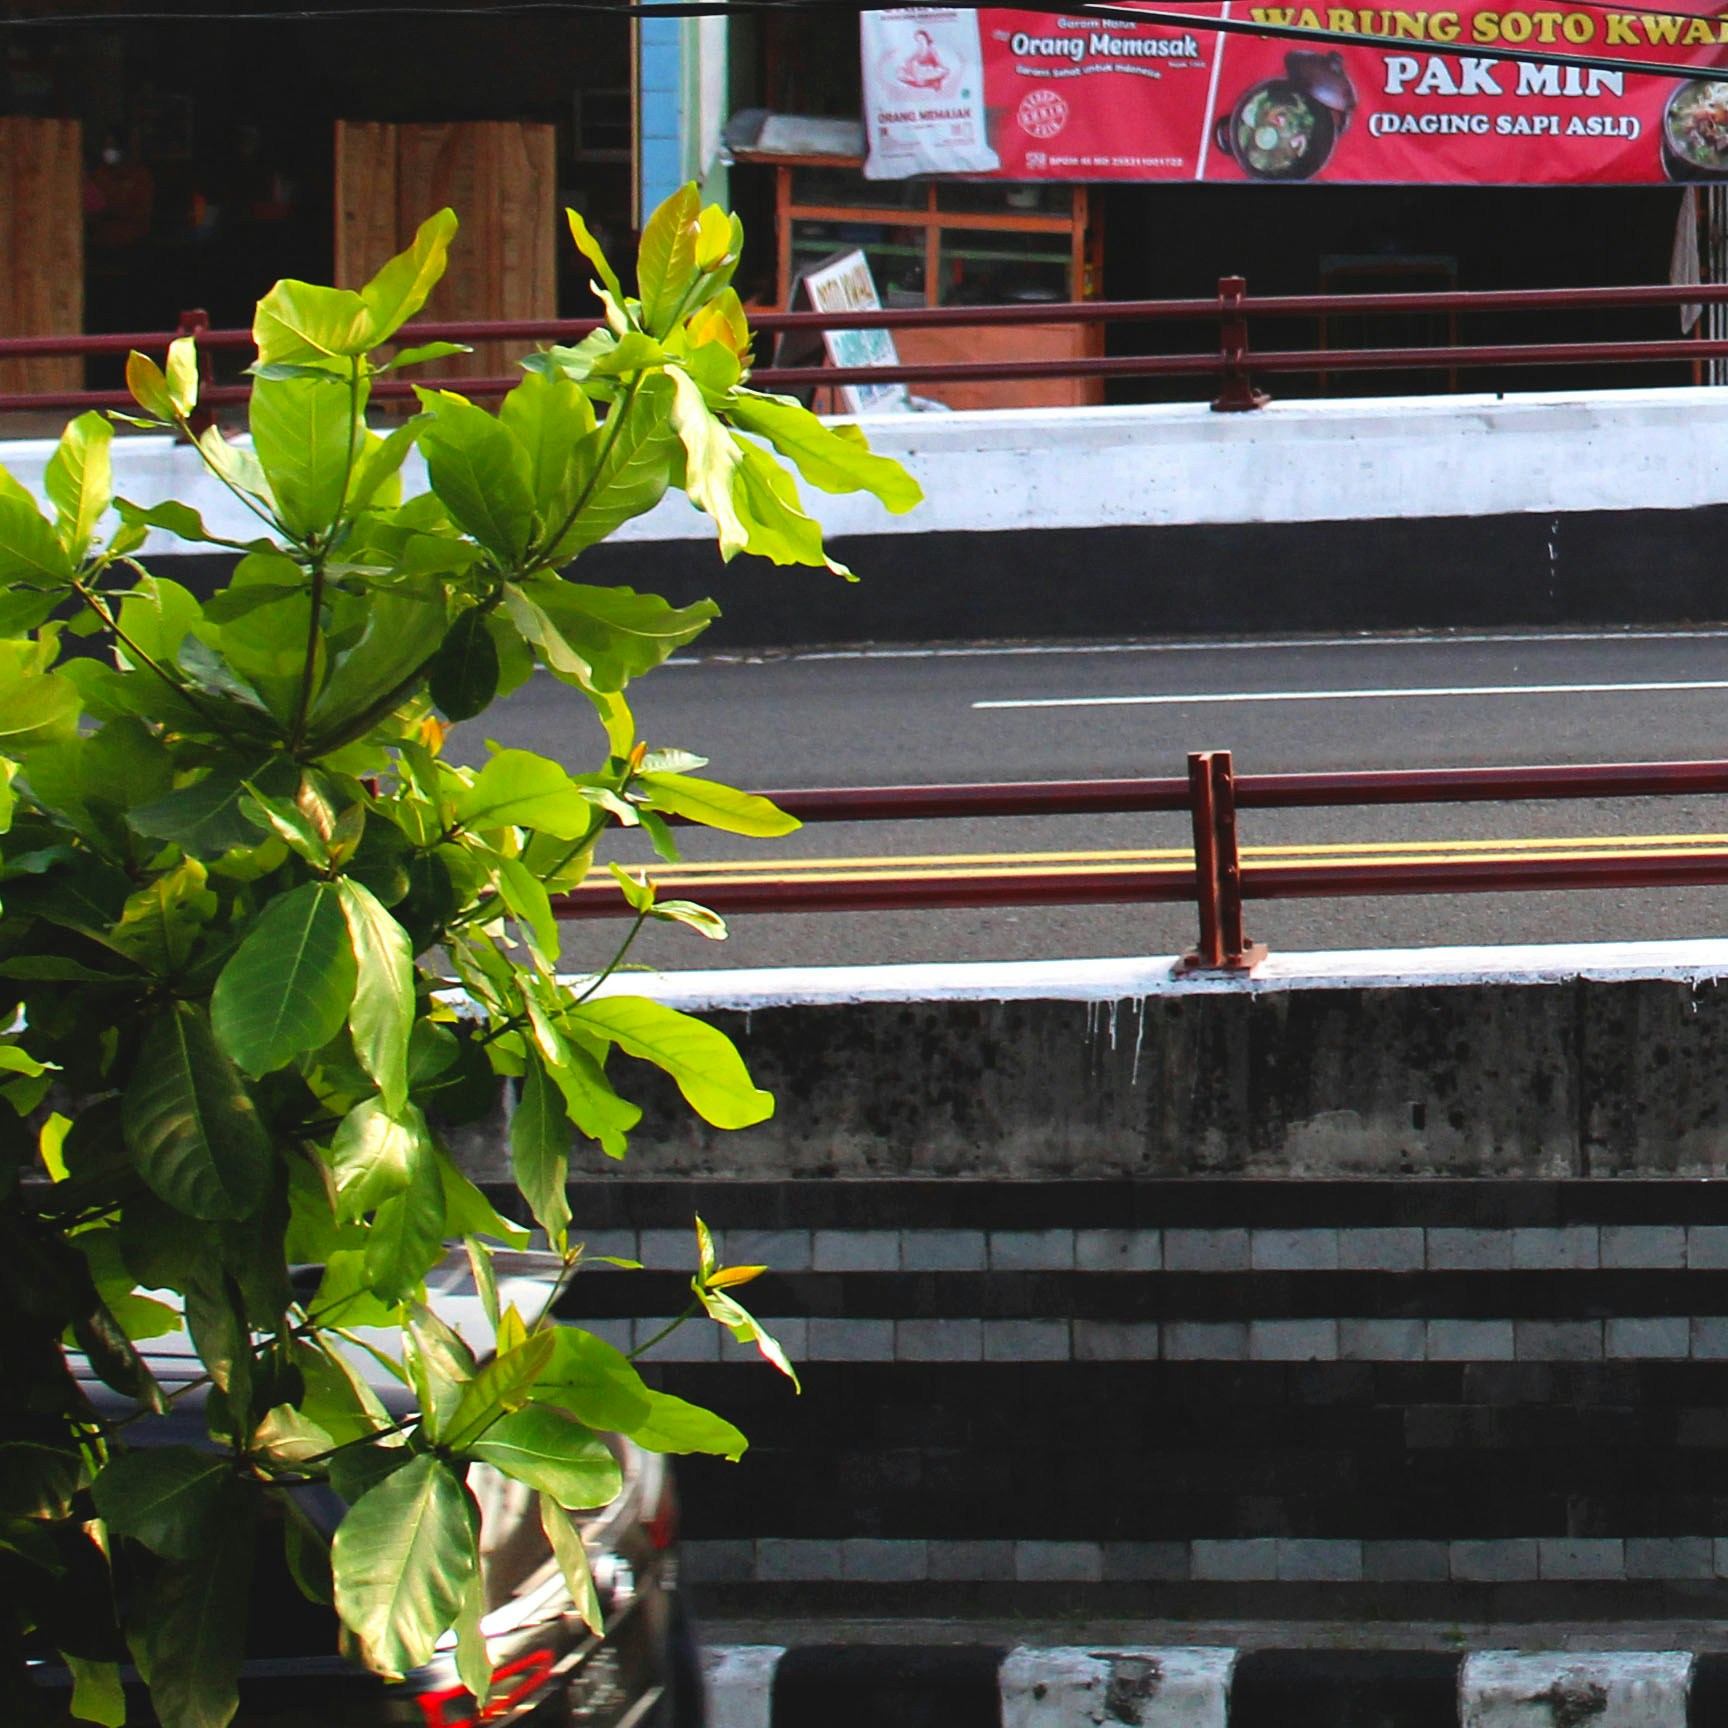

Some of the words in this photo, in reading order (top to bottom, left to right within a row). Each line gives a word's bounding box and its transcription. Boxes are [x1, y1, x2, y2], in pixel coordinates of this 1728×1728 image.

[1250, 7, 1462, 43] WARUNG
[1472, 10, 1595, 44] SOTO
[1011, 32, 1086, 61] Orang
[1089, 33, 1199, 58] Memasak
[1383, 56, 1504, 95] PAK
[1515, 58, 1625, 97] MIN
[1368, 112, 1490, 138] (DAGING
[1495, 115, 1560, 136] SAPI
[1566, 115, 1641, 141] ASLI)
